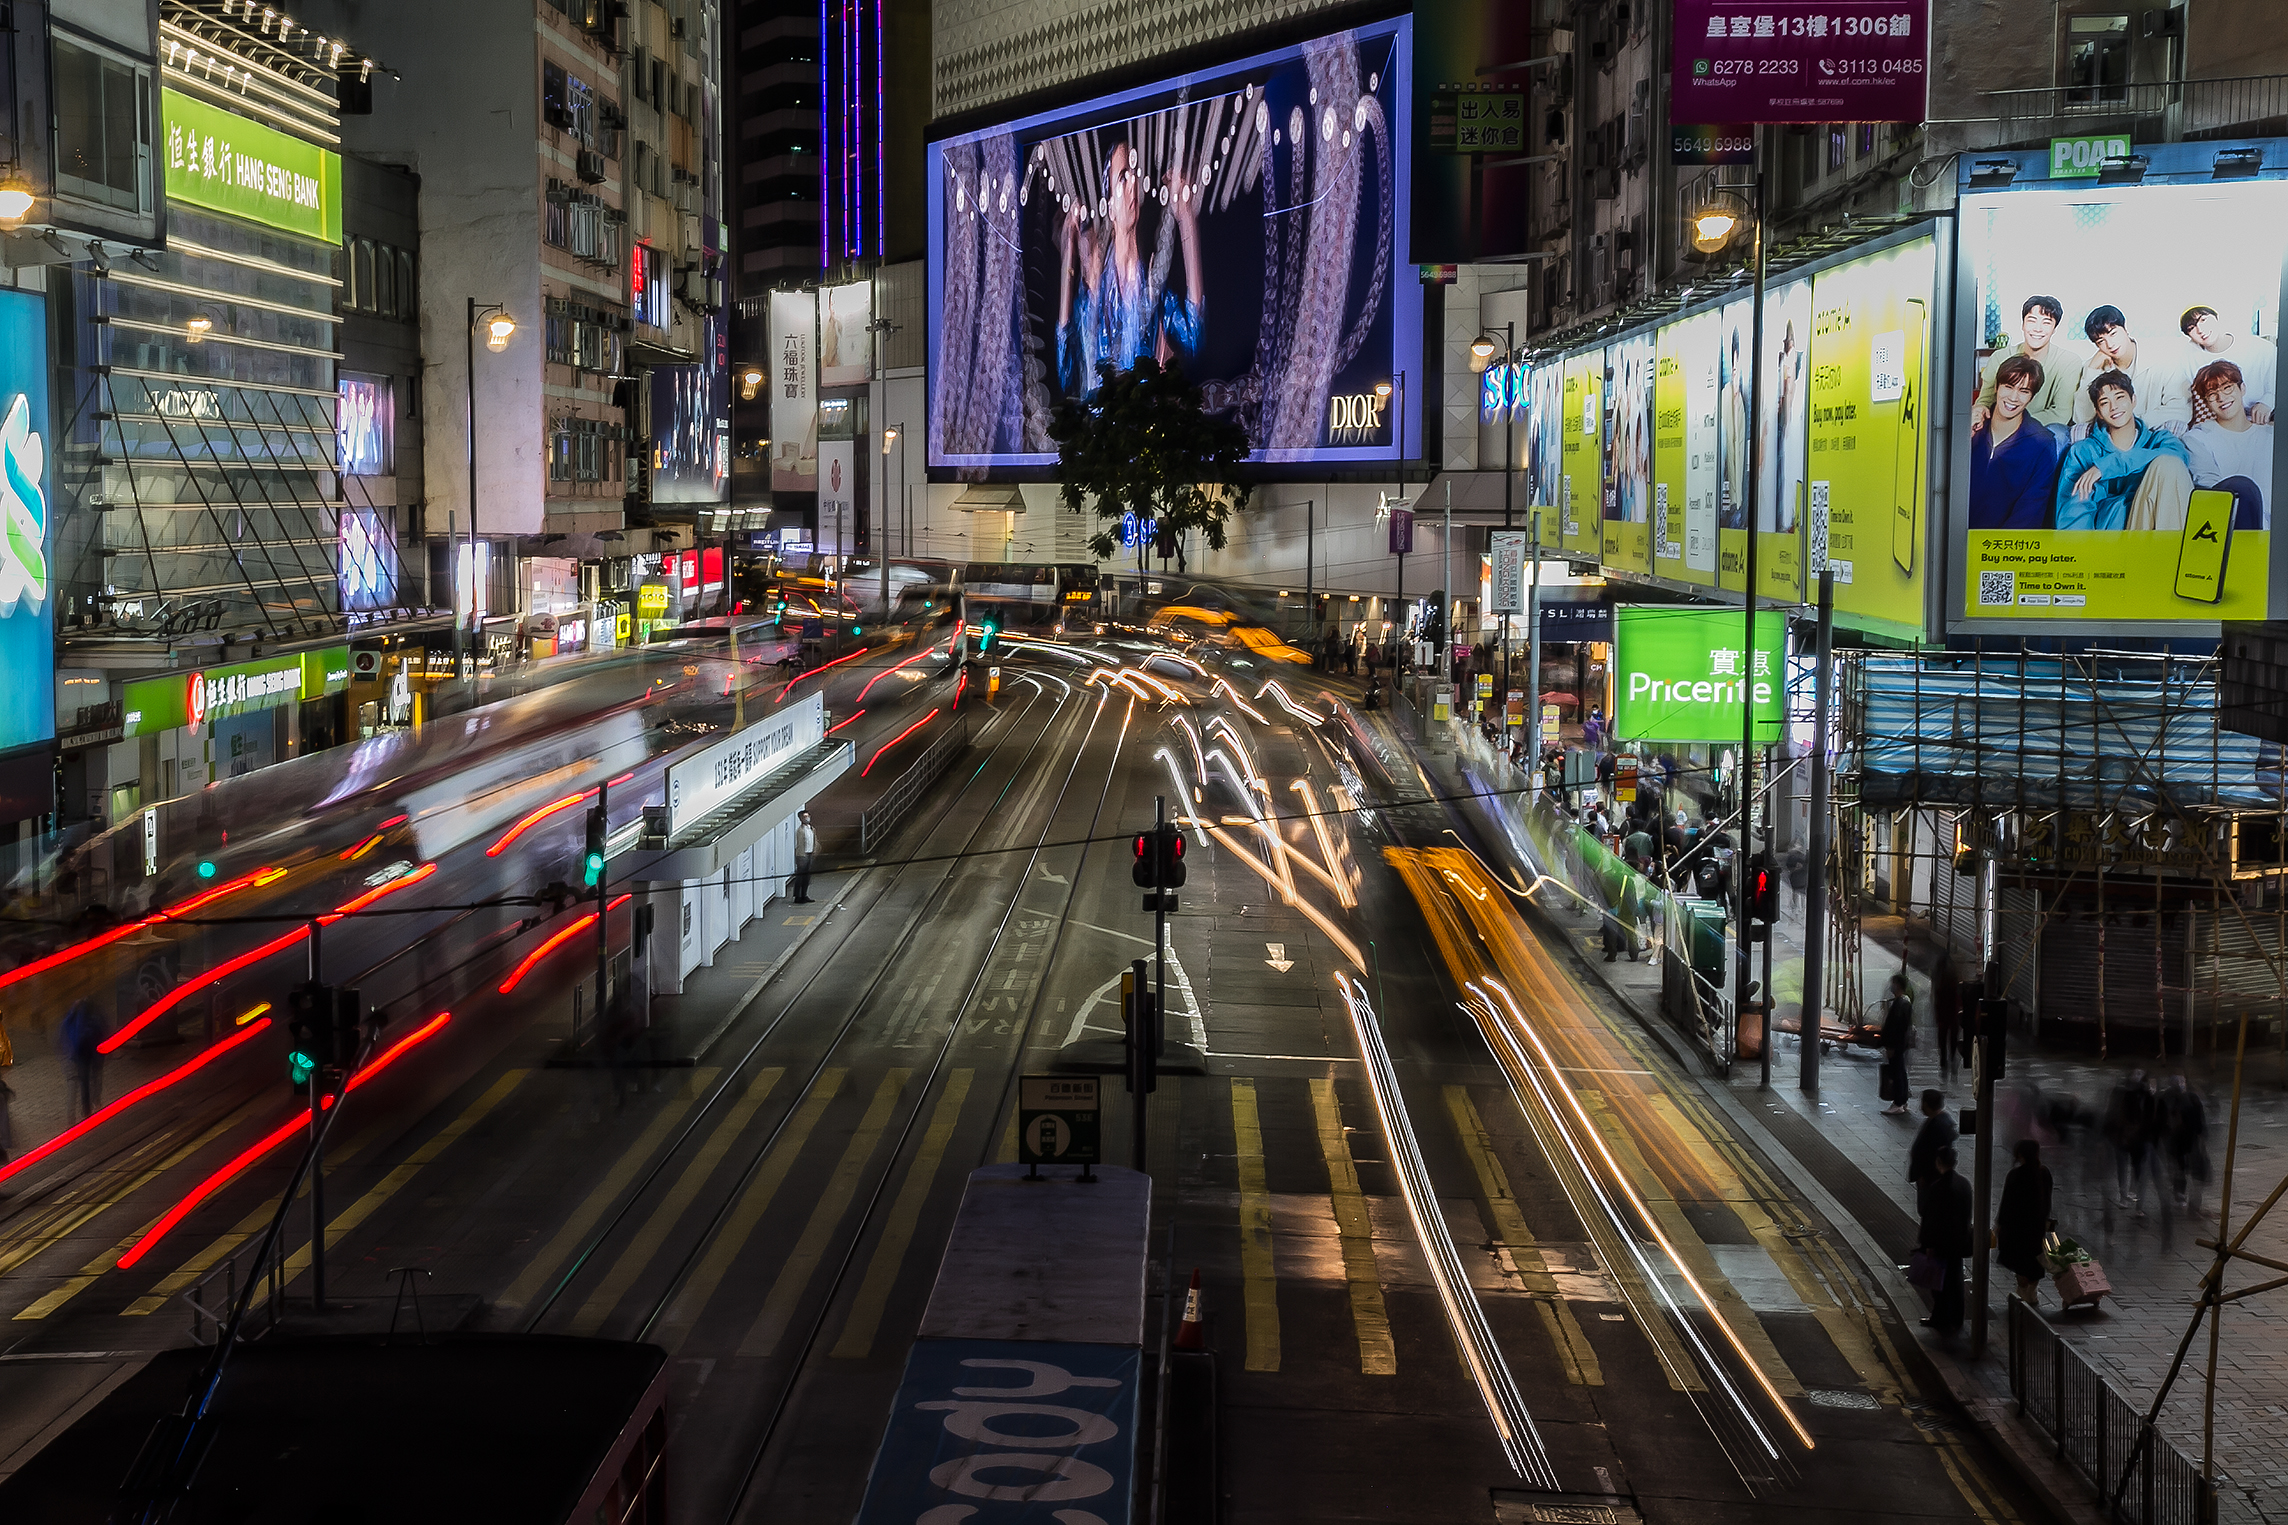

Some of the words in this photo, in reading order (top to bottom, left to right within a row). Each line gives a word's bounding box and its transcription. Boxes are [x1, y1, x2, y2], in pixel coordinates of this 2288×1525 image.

[1714, 60, 1754, 75] 6278
[1759, 60, 1799, 75] 2233
[1838, 59, 1877, 74] 3113
[1882, 59, 1922, 74] 0485
[1692, 77, 1737, 88] WhatsApp
[1461, 100, 1521, 120] 出入易
[1460, 126, 1520, 146] 迷你倉
[1674, 137, 1711, 152] 5649
[1714, 137, 1752, 152] 6988
[168, 120, 232, 185] 恒生銀行
[236, 152, 264, 193] HANG
[266, 163, 292, 201] SENG
[293, 172, 320, 210] BANK
[783, 333, 799, 399] 六福珠寶
[1331, 393, 1381, 429] DIOR
[1982, 539, 2041, 550] 今天只付1/3
[1502, 550, 1510, 577] HONG
[1981, 553, 2000, 564] Buy
[2002, 555, 2026, 563] now,
[2028, 555, 2048, 564] pay
[2050, 554, 2077, 563] later.
[1502, 579, 1510, 607] KONG
[2019, 582, 2041, 590] Time
[2042, 582, 2052, 590] to
[2054, 582, 2075, 590] Own
[2076, 582, 2087, 590] it.
[1709, 647, 1771, 677] 實惠
[1629, 672, 1772, 704] Pricerite
